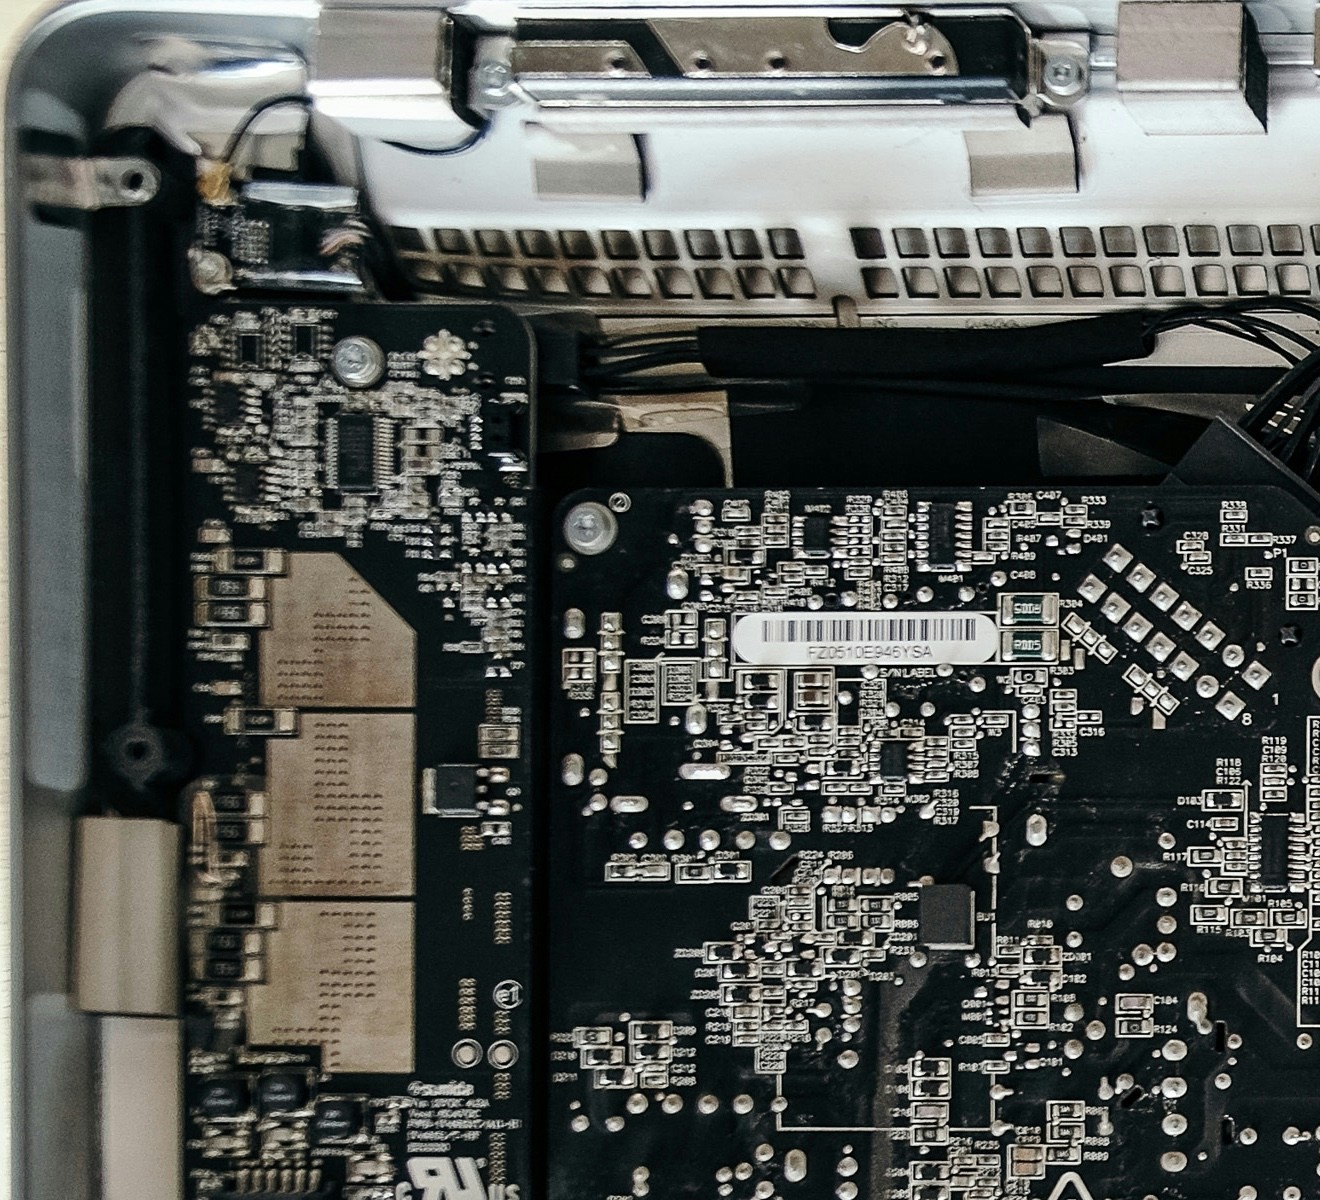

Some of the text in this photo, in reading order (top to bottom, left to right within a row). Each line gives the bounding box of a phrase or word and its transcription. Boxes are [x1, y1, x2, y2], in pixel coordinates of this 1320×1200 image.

[1273, 548, 1287, 558] P1
[808, 646, 933, 659] FZ0510E946YSA
[902, 669, 937, 677] LABEL
[1272, 693, 1279, 705] 1
[1242, 713, 1252, 725] 8
